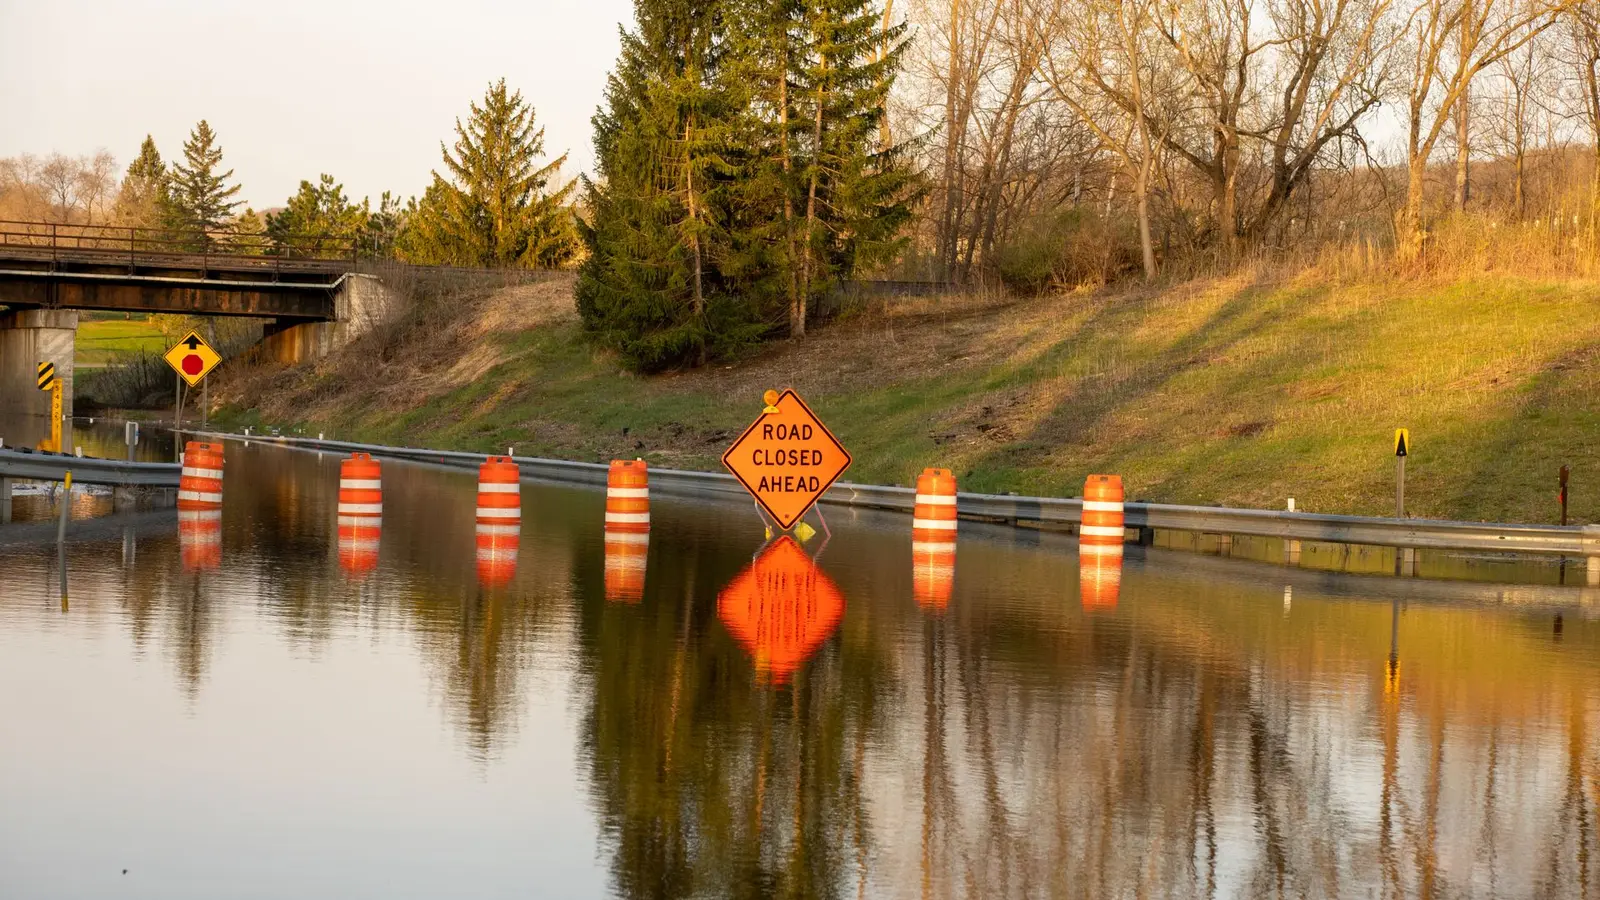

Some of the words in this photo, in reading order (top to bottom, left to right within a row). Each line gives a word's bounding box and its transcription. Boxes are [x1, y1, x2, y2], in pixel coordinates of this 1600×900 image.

[763, 424, 813, 440] ROAD
[752, 449, 823, 466] CLOSED
[758, 476, 820, 492] AHEAD
